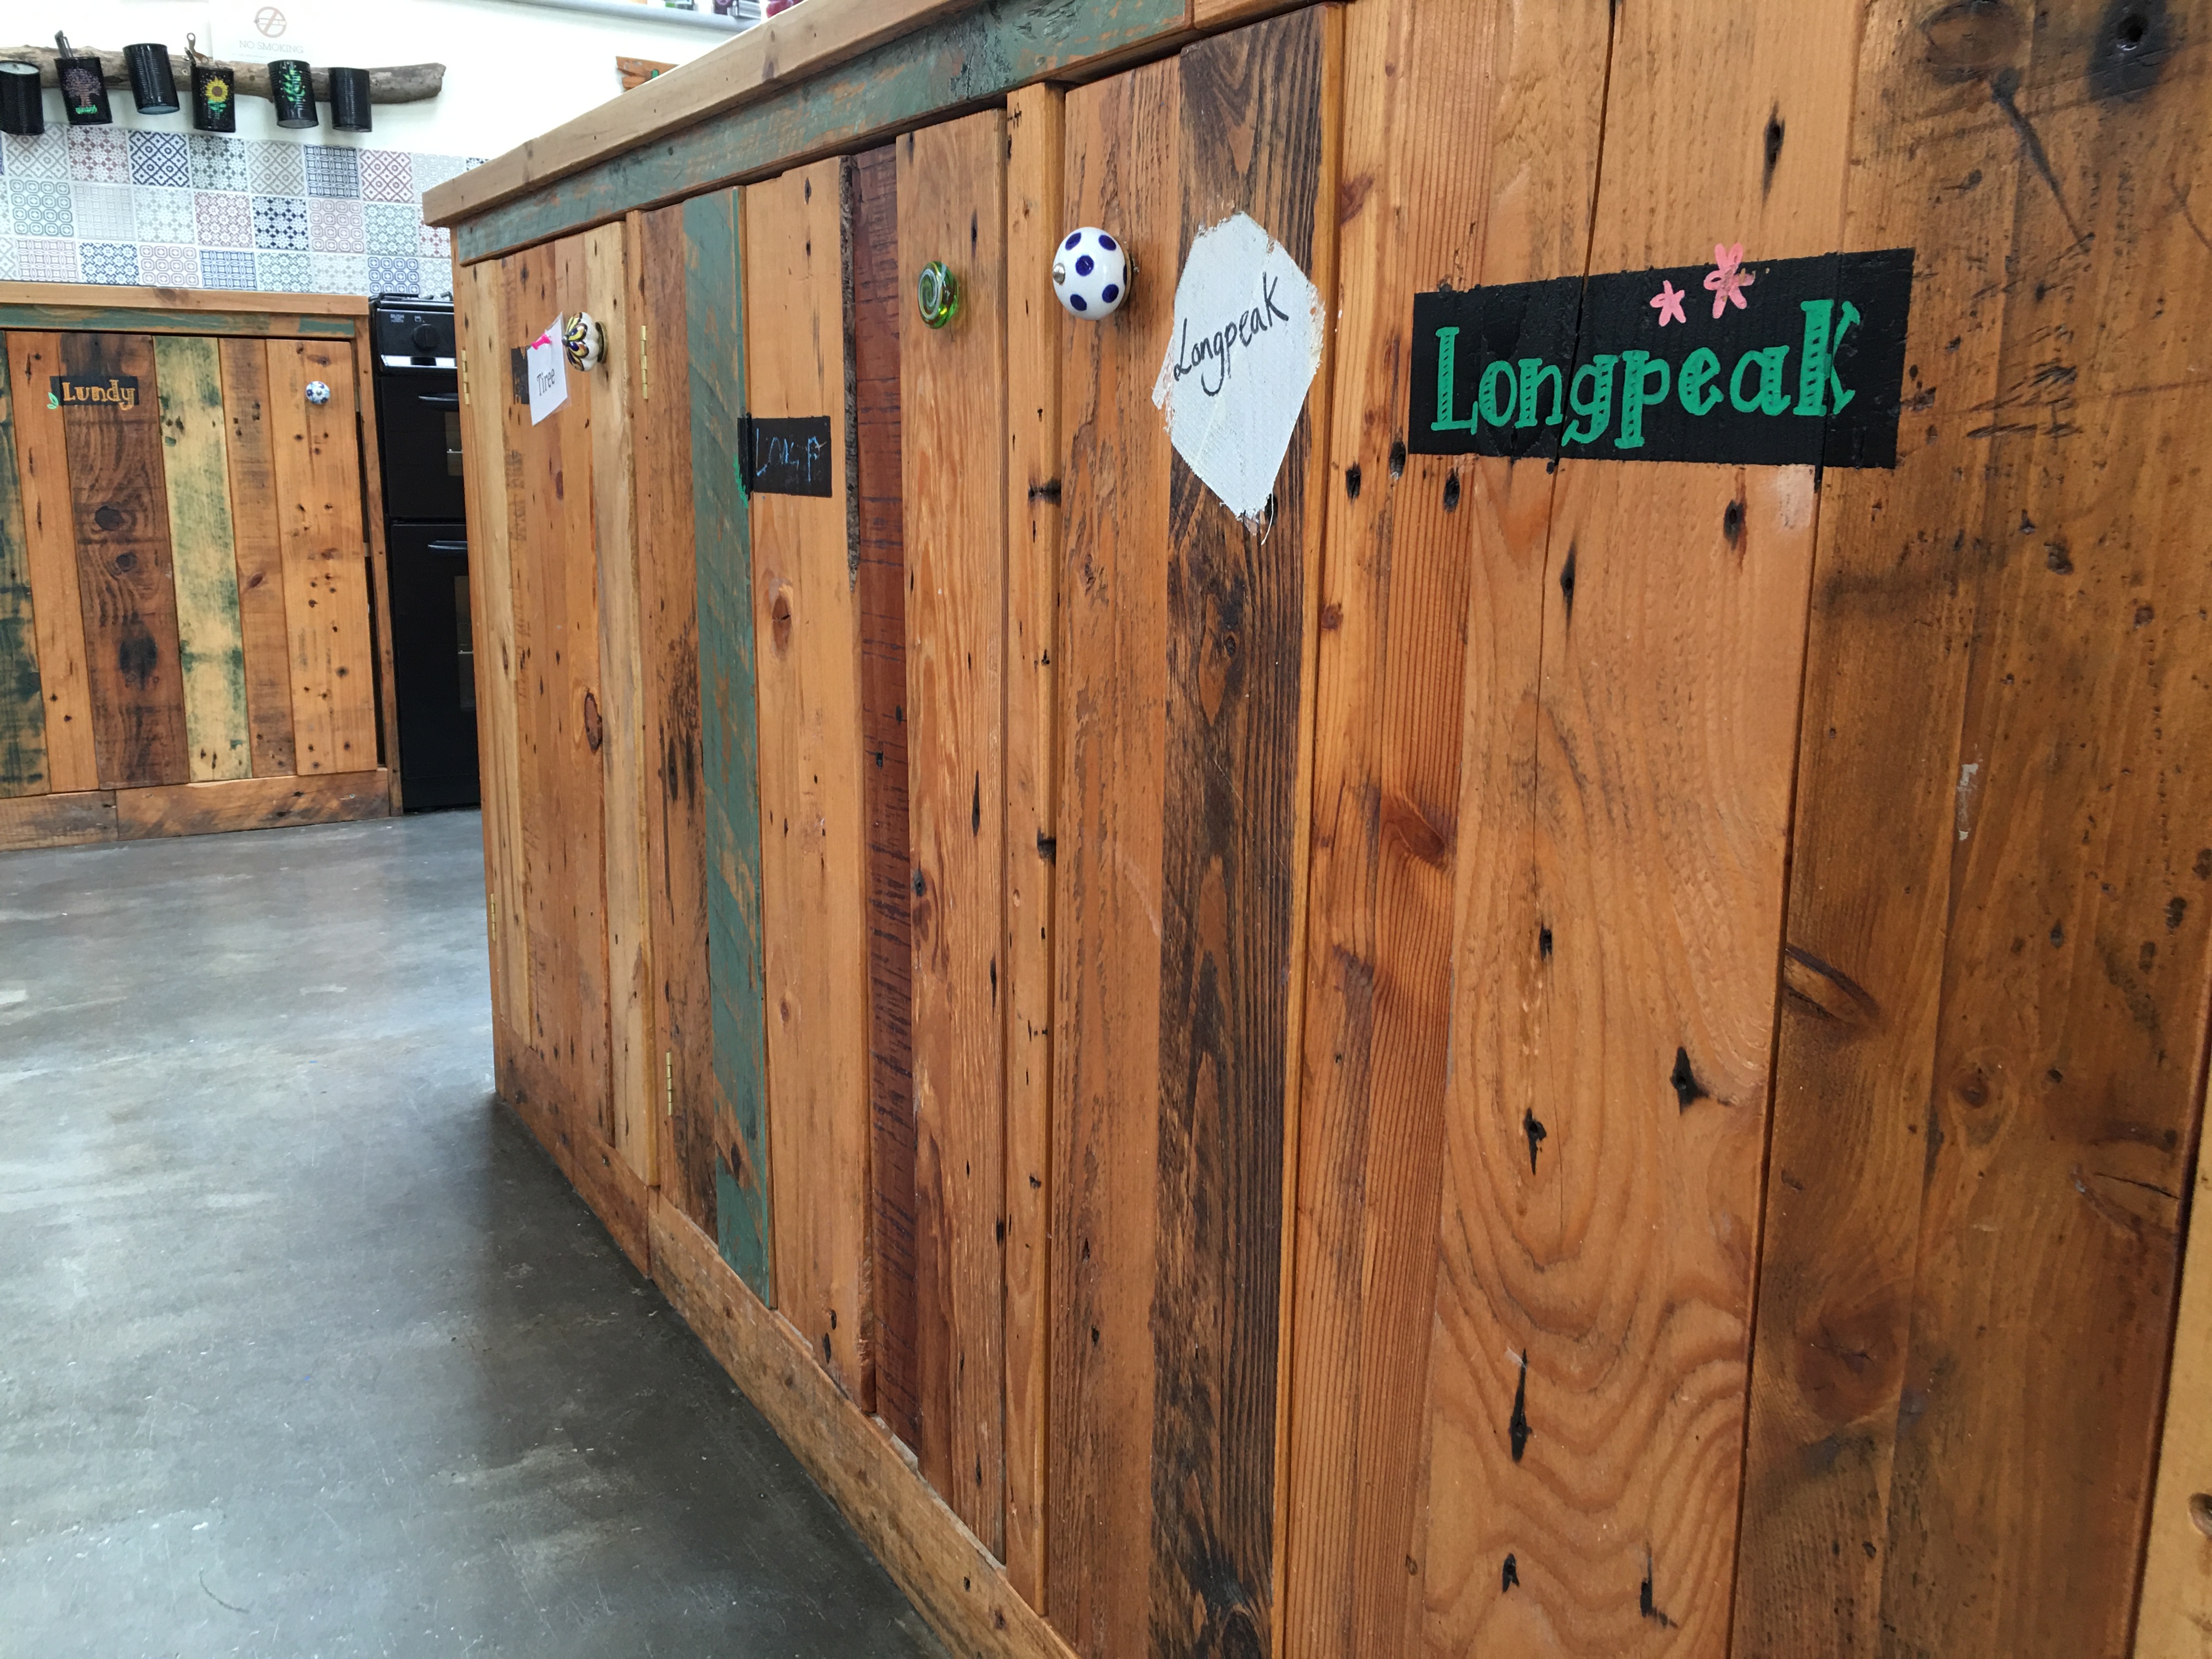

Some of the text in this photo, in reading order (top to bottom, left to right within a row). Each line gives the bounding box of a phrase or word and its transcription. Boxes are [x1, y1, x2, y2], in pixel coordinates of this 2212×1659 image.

[239, 40, 303, 54] NO SMOKING
[1173, 272, 1289, 397] Longpeak
[537, 368, 555, 396] Tiree
[1431, 299, 1860, 449] Longpeak
[62, 379, 136, 410] Lundy
